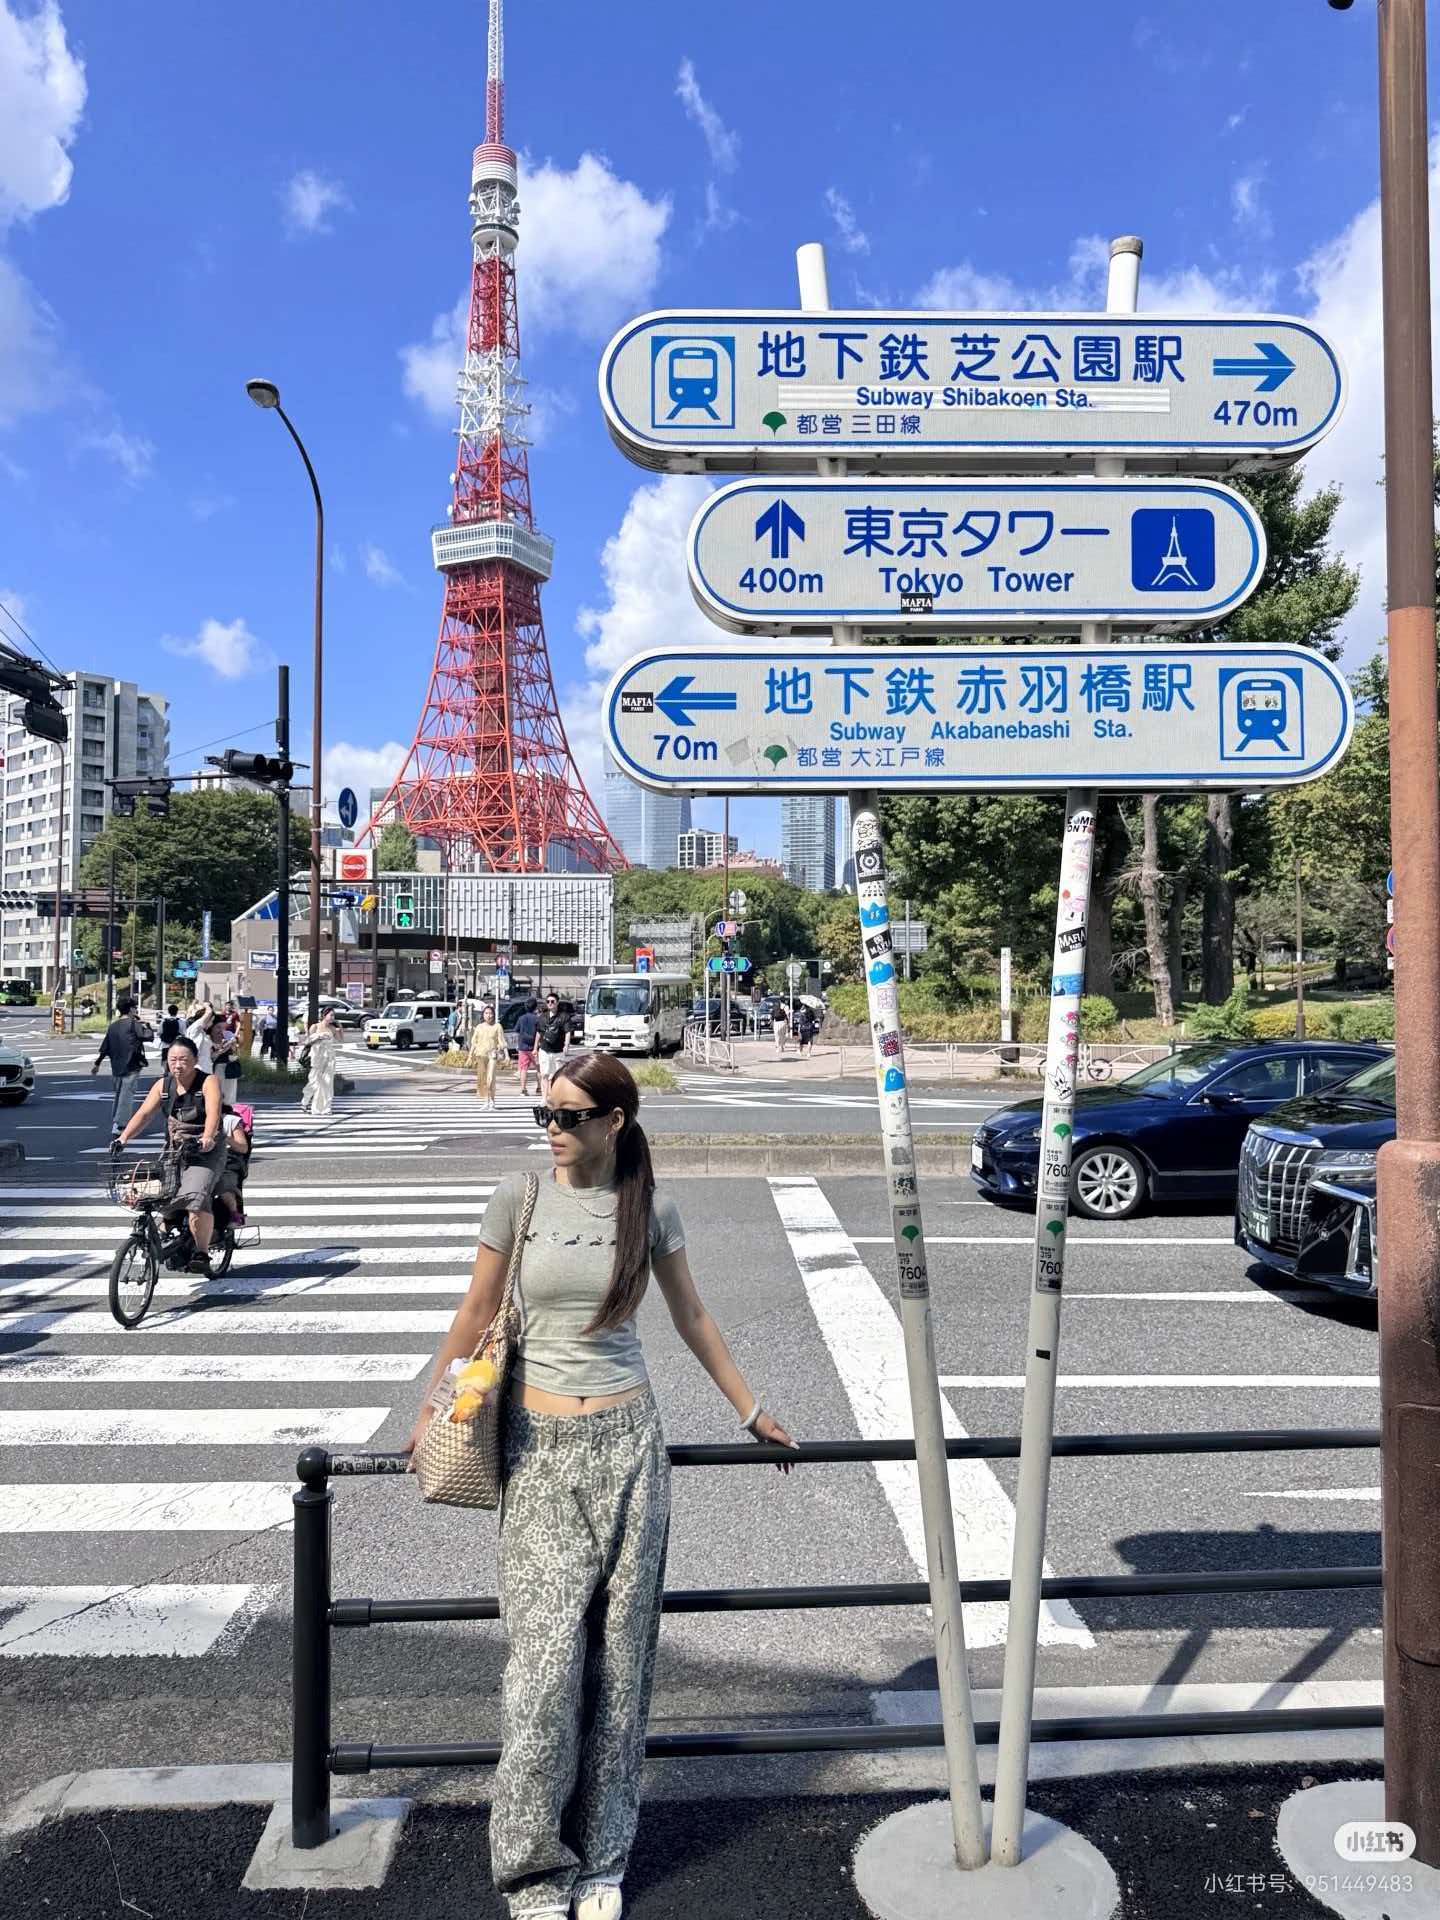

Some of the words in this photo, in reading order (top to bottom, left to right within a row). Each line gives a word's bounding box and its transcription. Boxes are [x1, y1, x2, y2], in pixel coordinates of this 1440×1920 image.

[856, 386, 934, 409] Subway
[942, 387, 1047, 408] Shibakoen
[1055, 387, 1093, 408] Sta.
[1213, 400, 1298, 426] 470m
[843, 505, 1111, 557] 東京タワー
[739, 567, 823, 593] 400m
[878, 567, 964, 598] Tokyo
[987, 567, 1075, 592] Tower
[901, 598, 932, 608] MAFIA
[622, 697, 653, 707] MAFIA
[830, 721, 906, 744] Subway
[930, 721, 1070, 740] Akabanebashi
[1093, 719, 1133, 738] Sta.
[653, 735, 718, 761] 70m
[1039, 1260, 1064, 1275] 760
